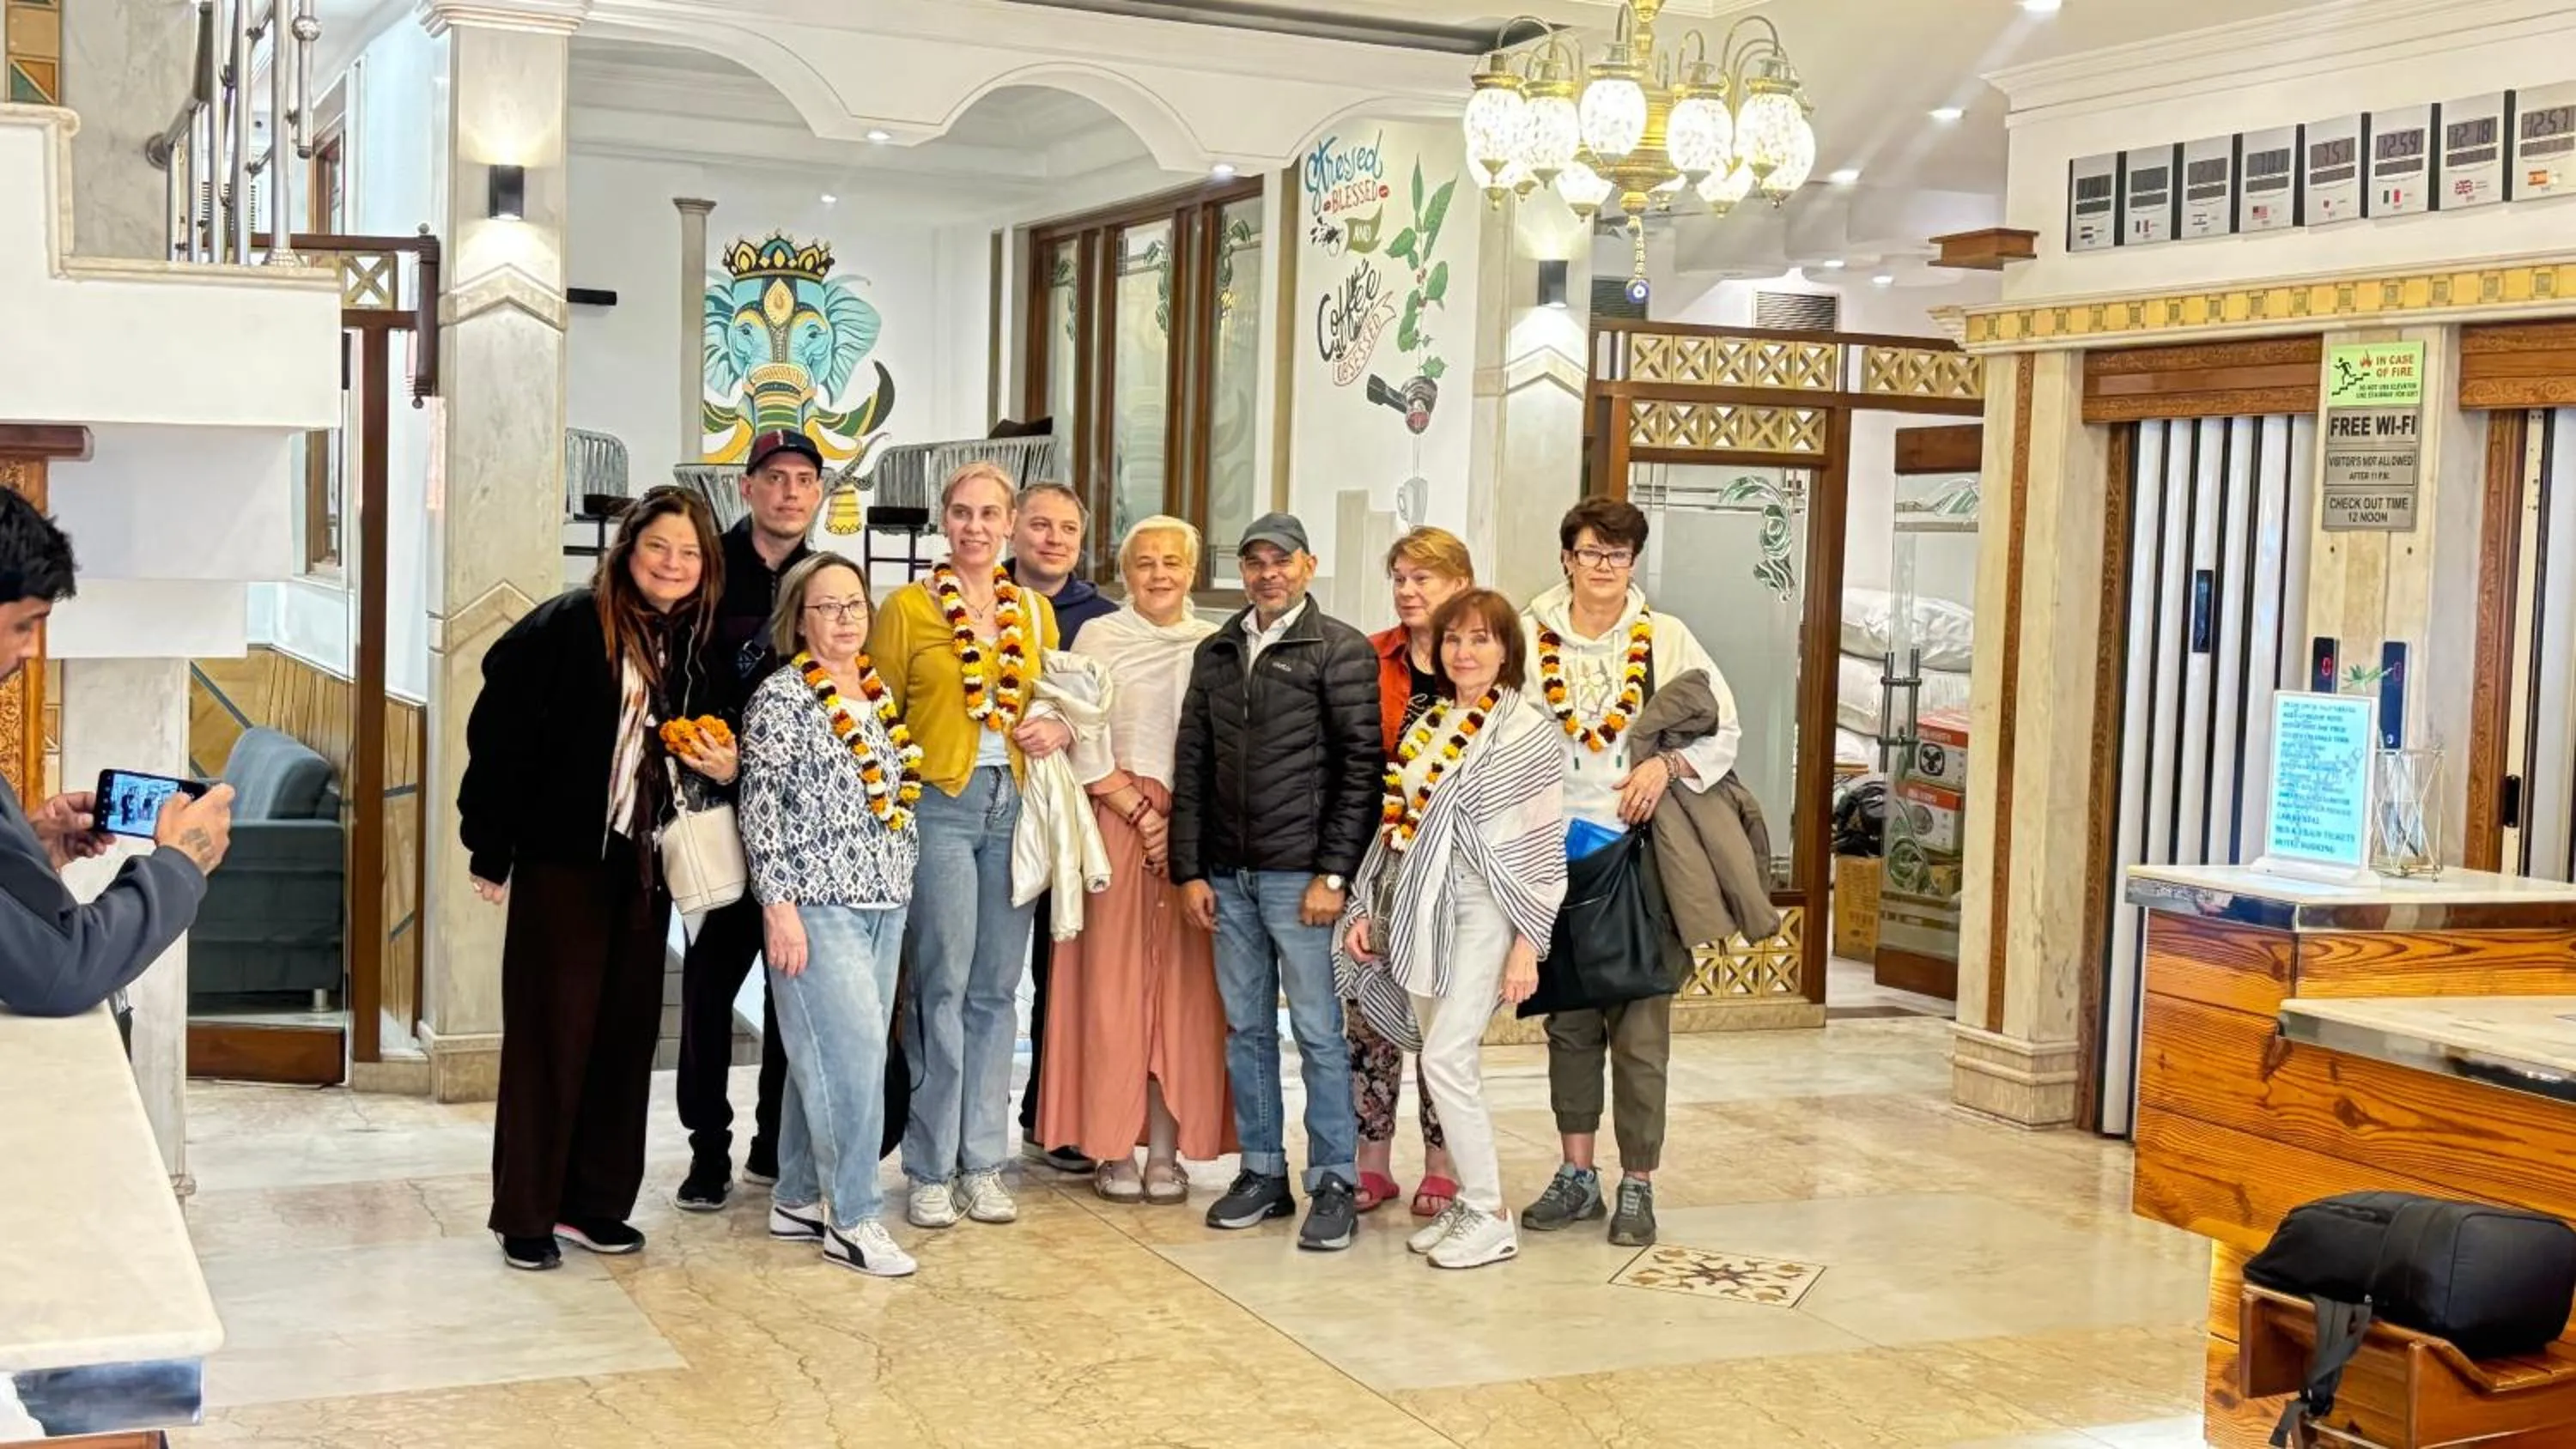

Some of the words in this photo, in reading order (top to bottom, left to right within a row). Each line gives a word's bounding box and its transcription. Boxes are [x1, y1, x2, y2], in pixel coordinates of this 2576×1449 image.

[1333, 179, 1378, 214] BLESSED
[1352, 223, 1372, 243] AND
[2376, 356, 2386, 366] IN
[2389, 355, 2415, 365] CASE
[2376, 368, 2388, 378] OF
[2391, 367, 2414, 377] FIRE
[2330, 416, 2371, 437] FREE
[2376, 415, 2415, 435] WI-FI
[2363, 456, 2377, 466] NOT
[2378, 455, 2414, 466] ALLOWED
[2349, 471, 2369, 480] AFTER
[2371, 471, 2378, 480] 11
[2329, 497, 2360, 510] CHECK
[2363, 497, 2384, 509] OUT
[2385, 497, 2409, 509] TIME
[2348, 511, 2358, 522] 12
[2360, 511, 2388, 522] NOON
